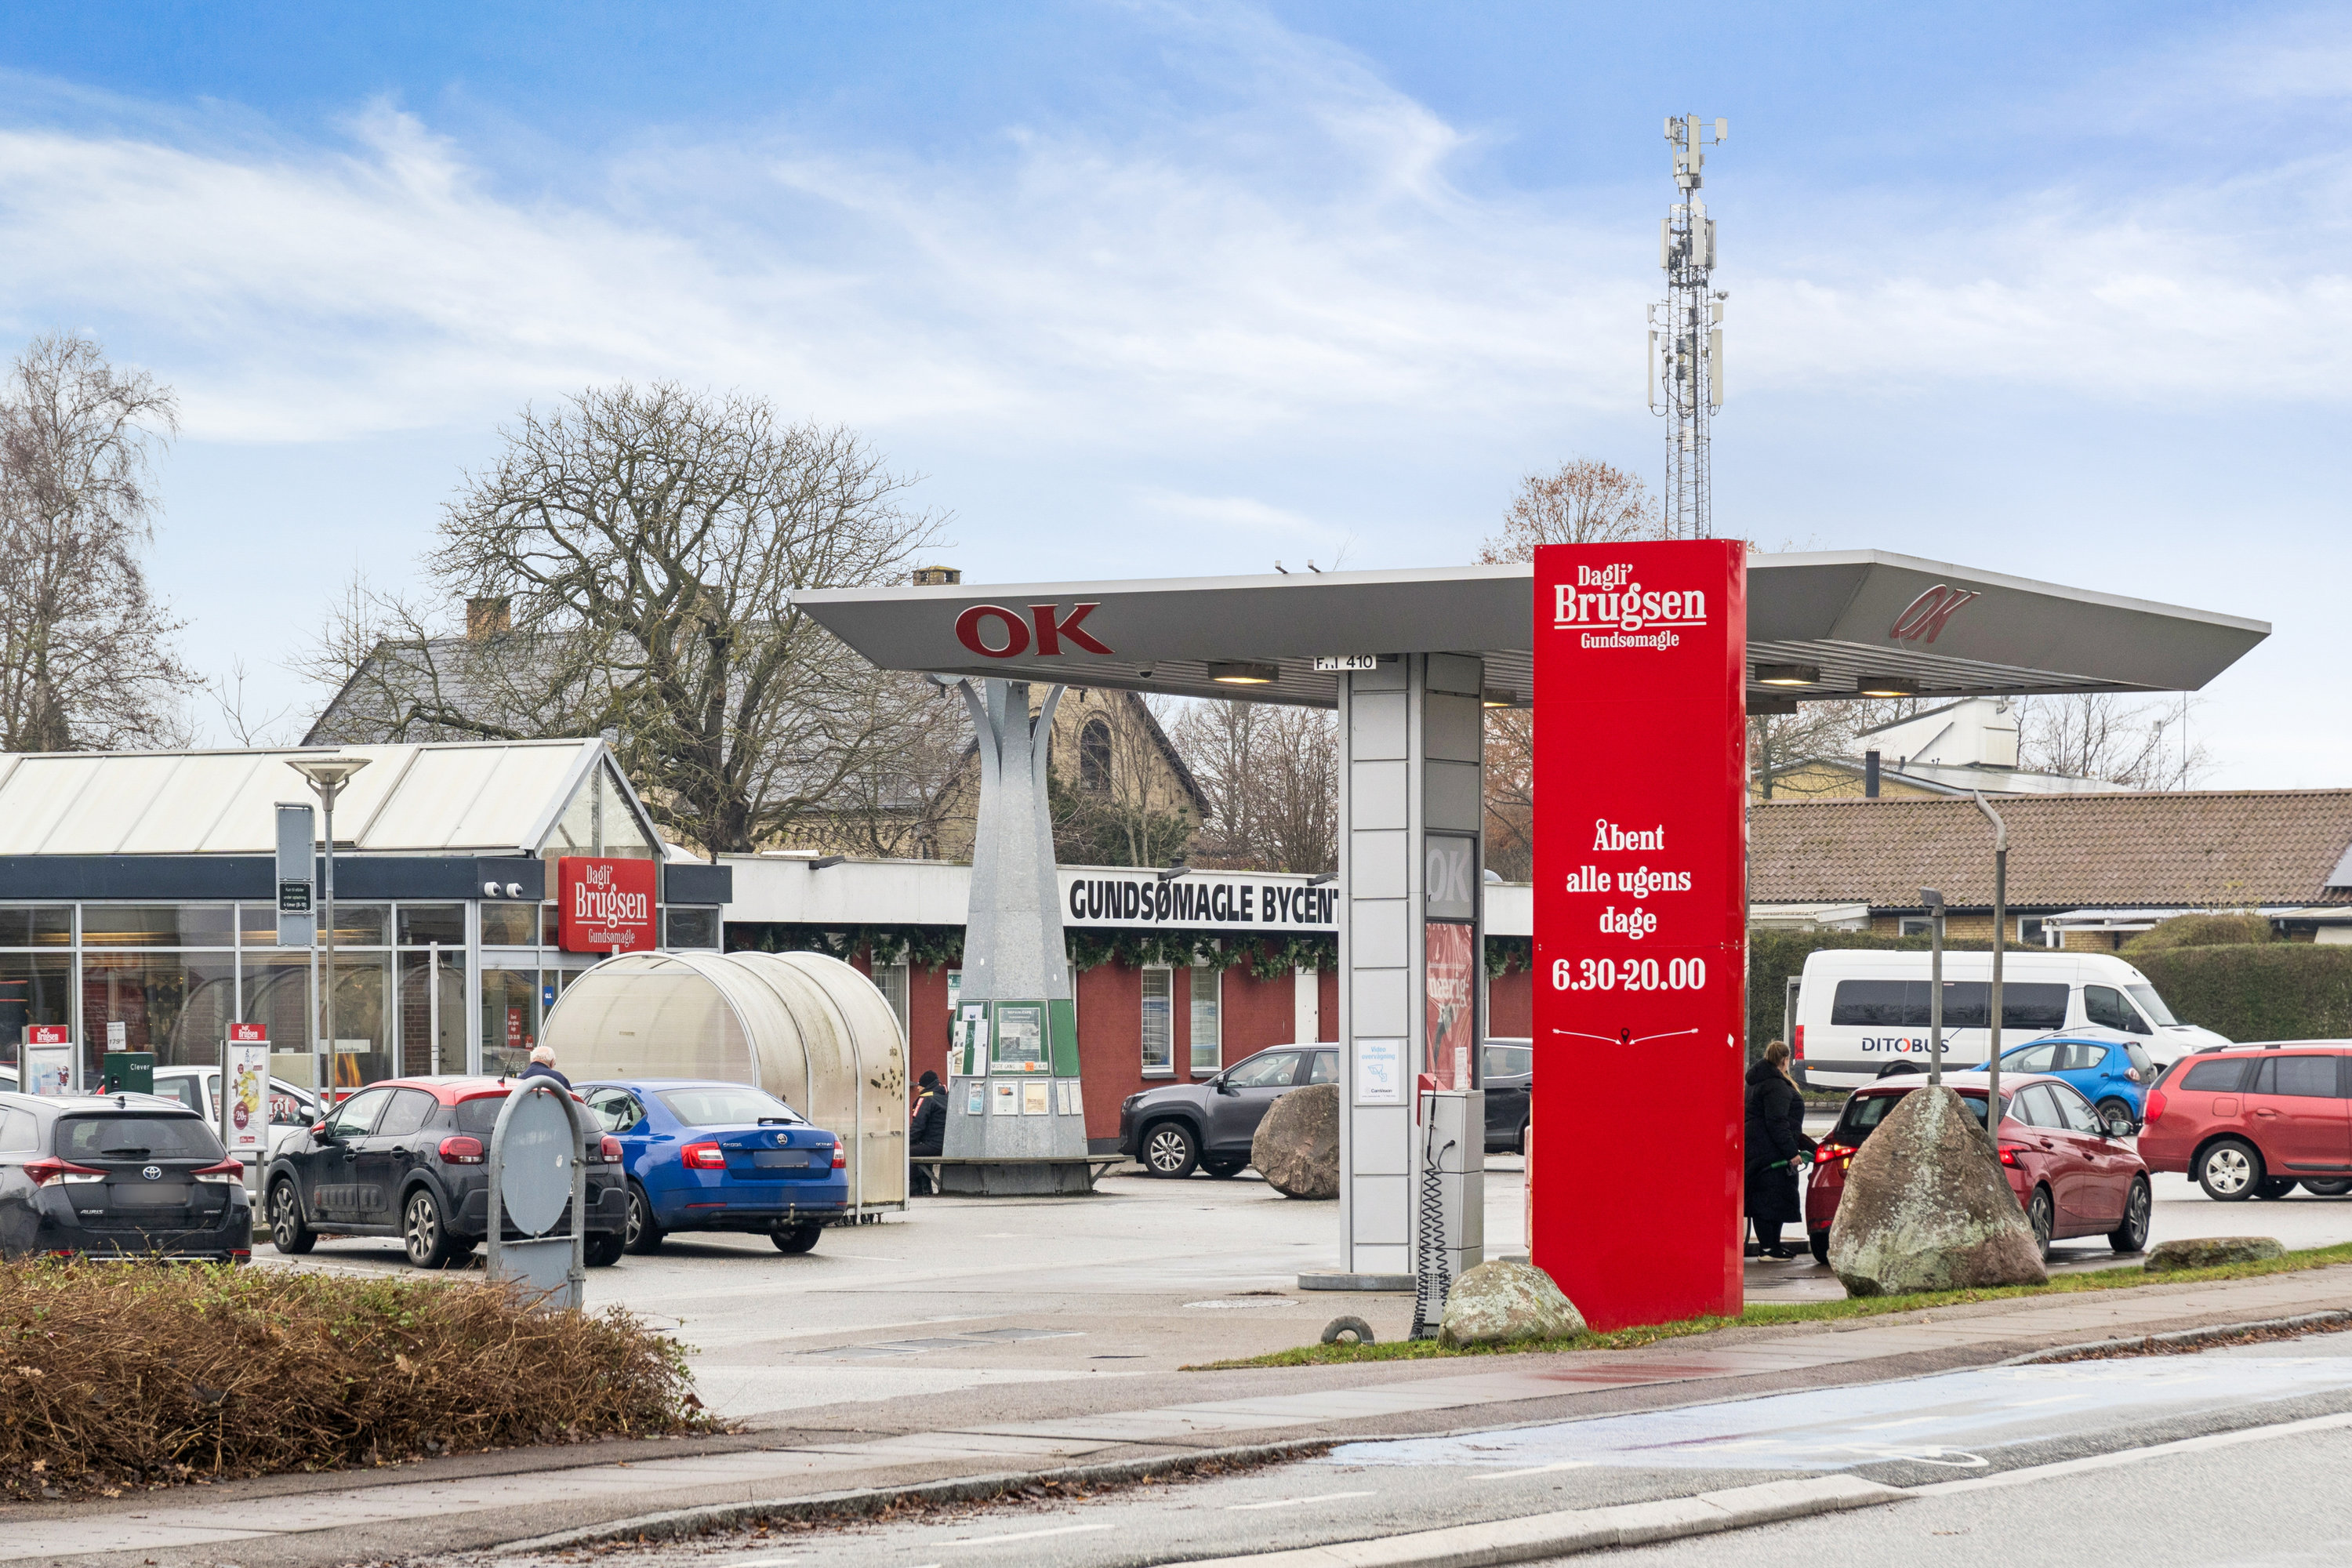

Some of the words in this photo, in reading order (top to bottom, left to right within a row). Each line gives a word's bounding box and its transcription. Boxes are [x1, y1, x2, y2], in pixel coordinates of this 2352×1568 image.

[1554, 583, 1707, 631] Brugsen
[1889, 583, 1981, 644] OK
[954, 602, 1116, 658] OK
[1581, 630, 1679, 652] Gundsømagle
[1346, 655, 1373, 668] 410
[1592, 818, 1664, 851] Åbent
[1426, 848, 1471, 902] OK
[1566, 866, 1611, 892] alle
[1617, 866, 1692, 898] ugens
[575, 882, 648, 928] Brugsen
[1069, 879, 1254, 924] GUNDSØMAGLE
[1599, 906, 1657, 940] dage
[1552, 957, 1706, 991] 6.30-20.00
[37, 1032, 59, 1043] Brugsen
[238, 1029, 258, 1040] Brugsen
